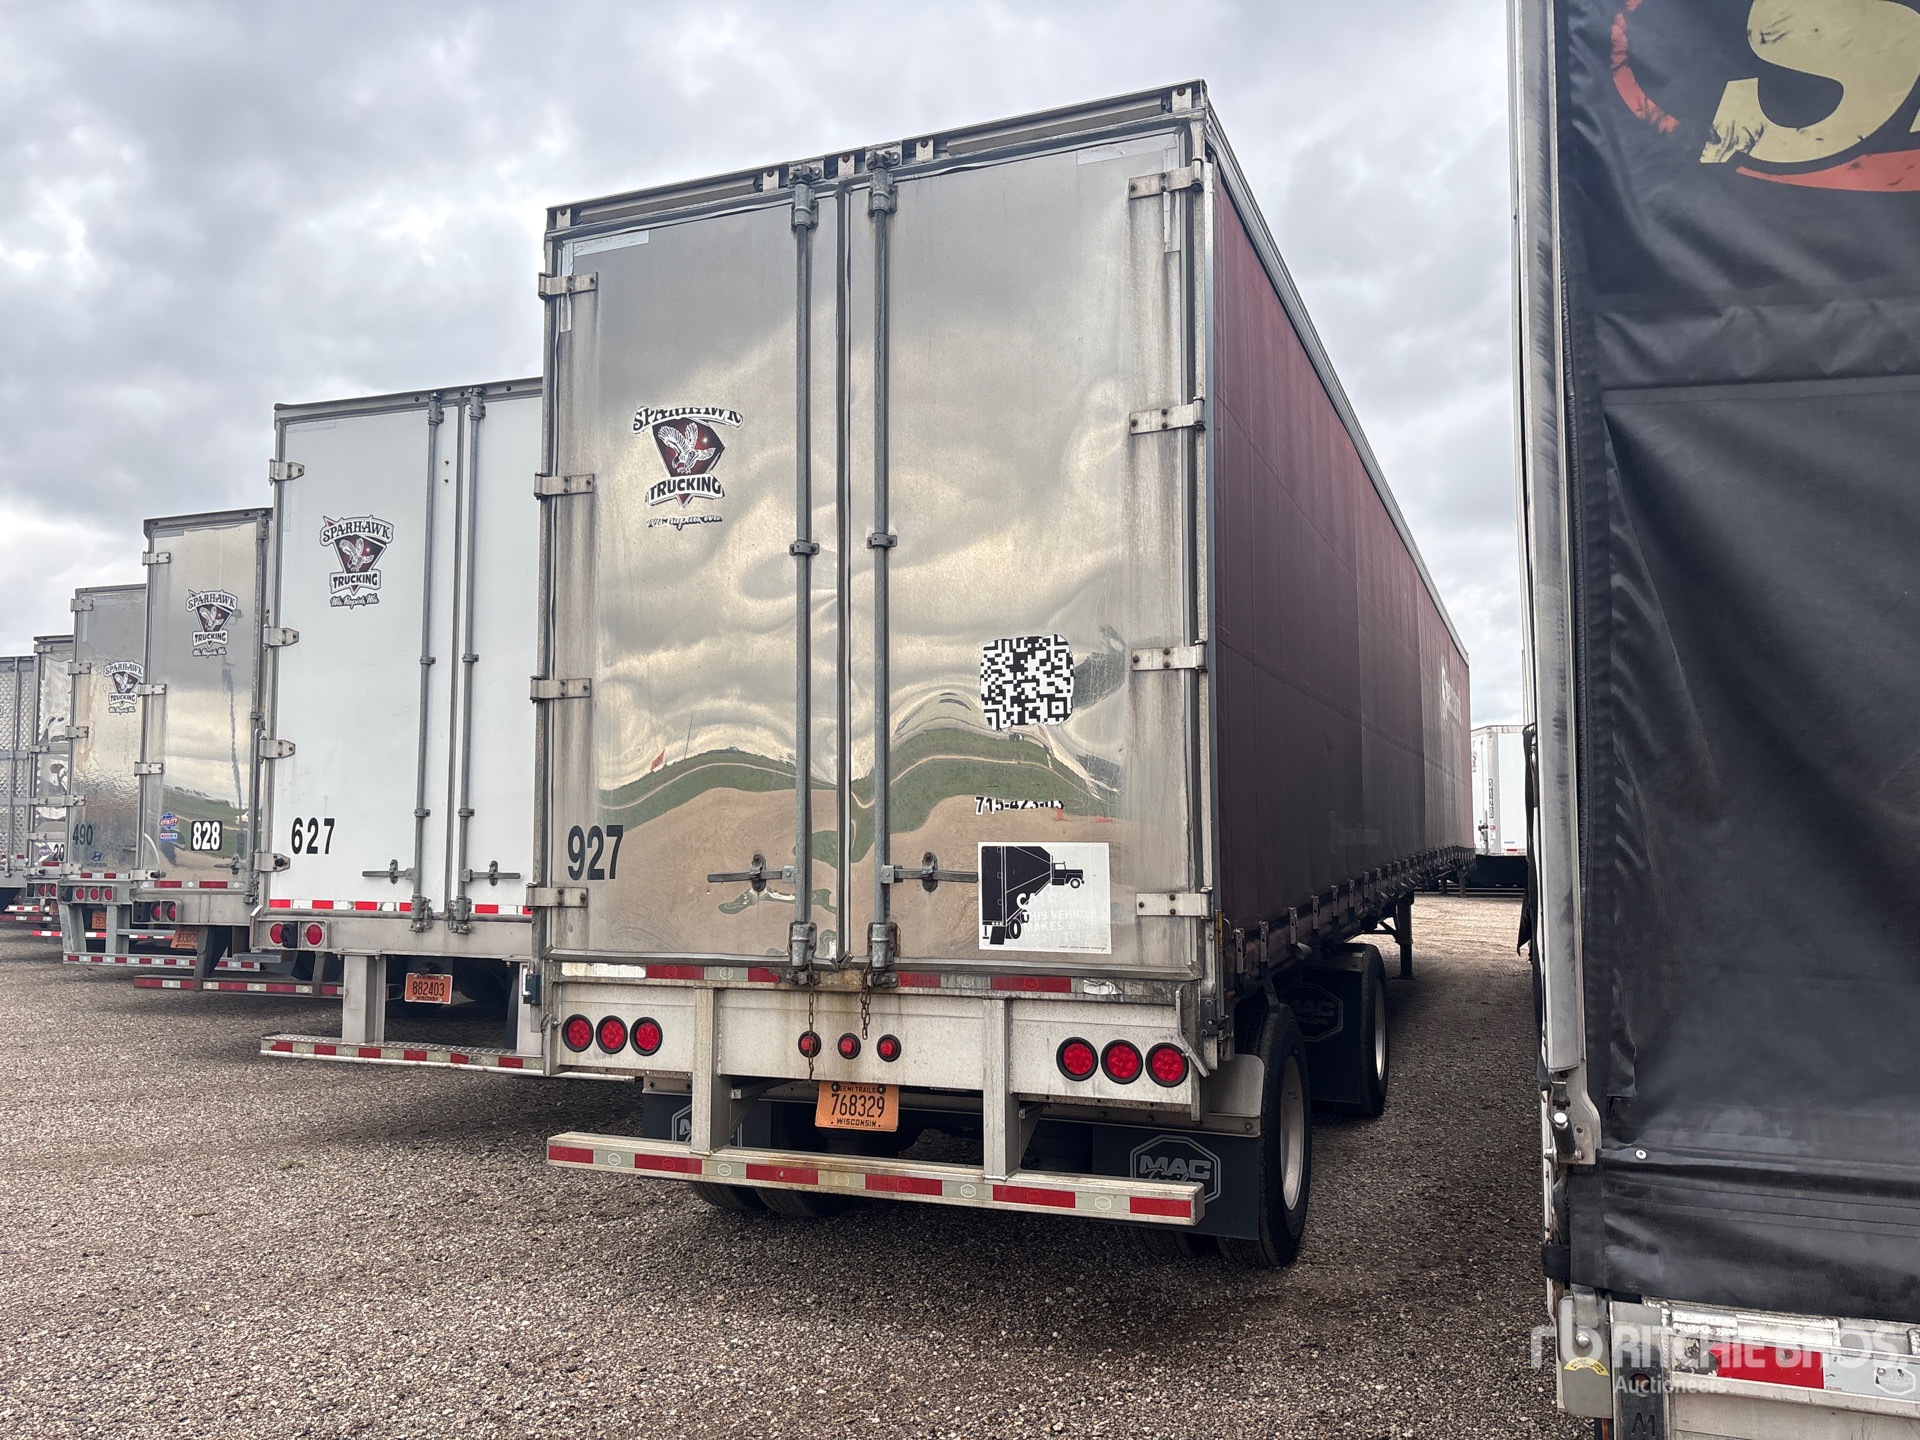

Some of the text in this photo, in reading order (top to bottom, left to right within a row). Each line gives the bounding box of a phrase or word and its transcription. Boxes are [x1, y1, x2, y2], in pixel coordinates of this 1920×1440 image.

[650, 476, 722, 500] TRUCKING
[323, 520, 391, 542] SPARHAWK
[333, 573, 378, 588] TRUCKING
[188, 594, 236, 609] SPARHAWK
[195, 633, 227, 643] TRUCKING
[73, 824, 93, 846] 490
[192, 821, 221, 851] 828
[291, 817, 335, 855] 627
[567, 825, 624, 881] 927
[413, 981, 445, 997] 882403
[831, 1094, 885, 1118] 768329
[836, 1118, 877, 1127] WISCONSIN
[1140, 1155, 1212, 1180] MAC
